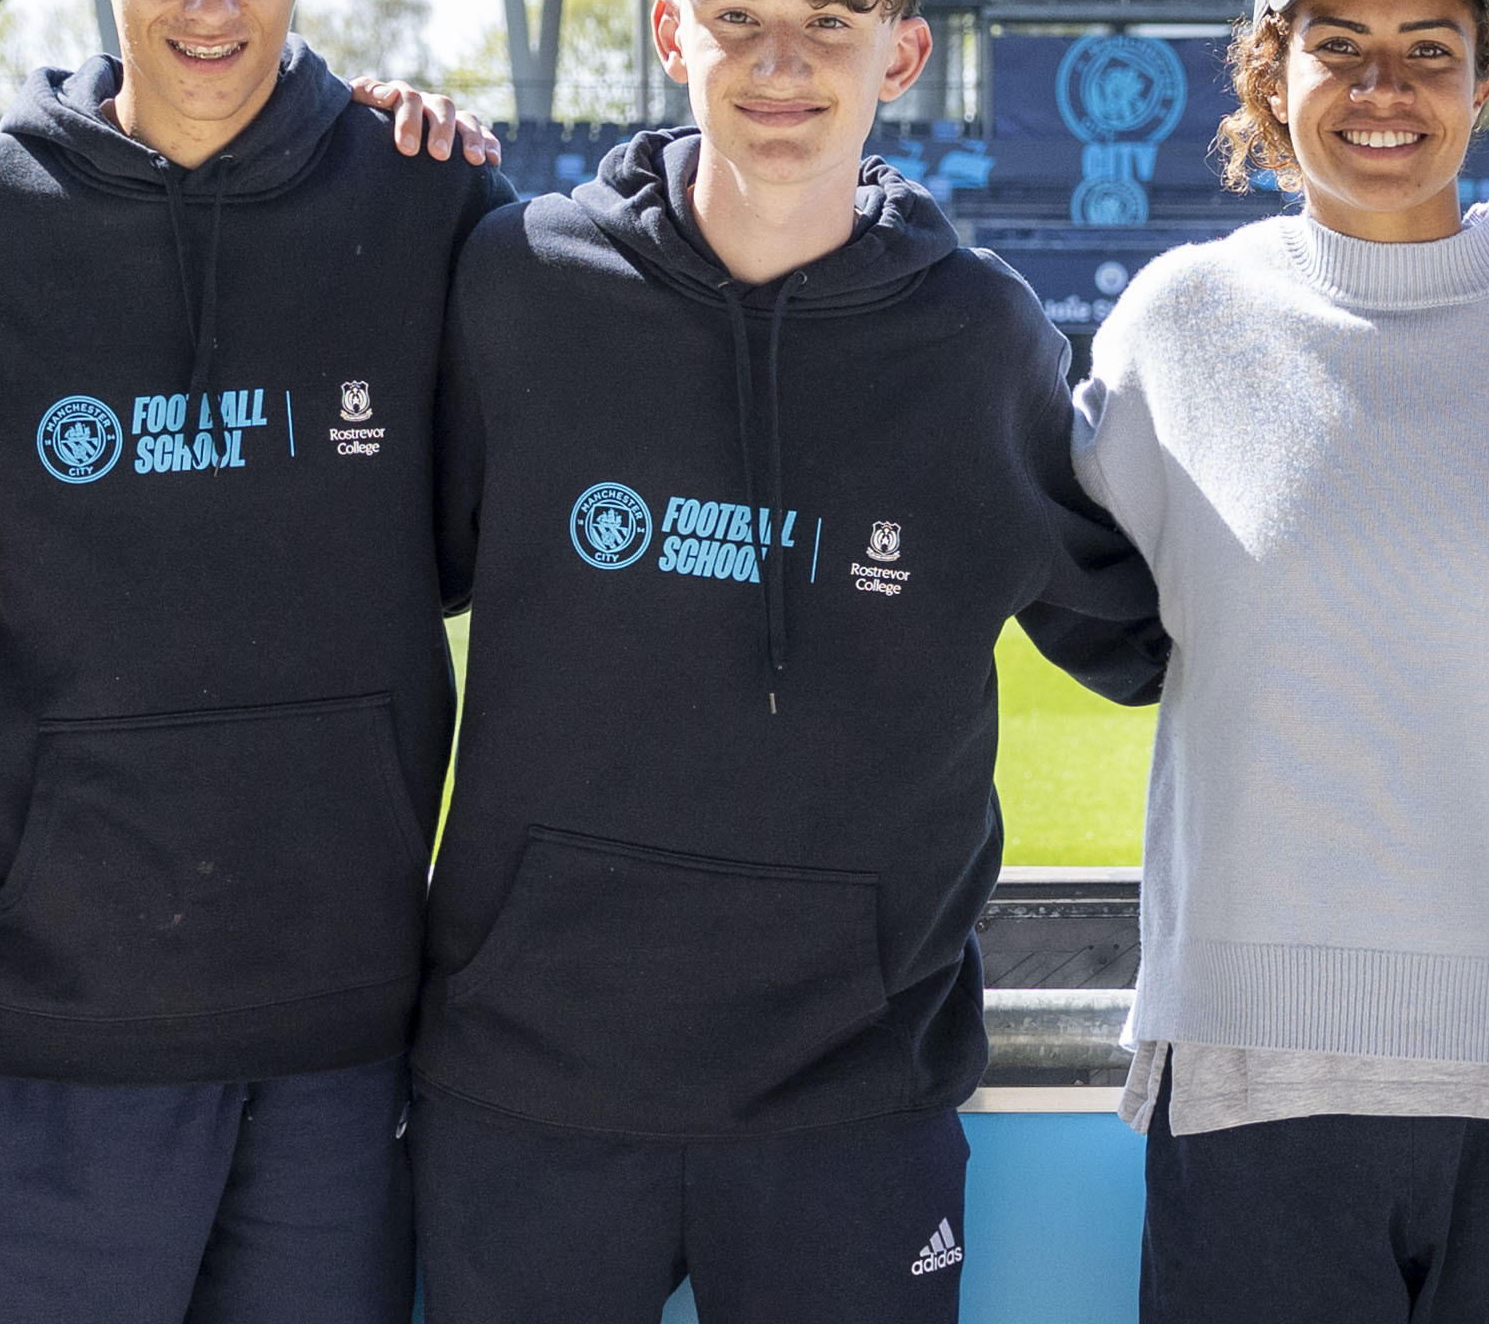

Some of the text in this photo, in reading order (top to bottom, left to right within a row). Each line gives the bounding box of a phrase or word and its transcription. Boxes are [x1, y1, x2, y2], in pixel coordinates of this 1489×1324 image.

[46, 403, 112, 432] MANCHESTER
[132, 388, 267, 435] FOOBALL
[329, 428, 385, 442] Rostrevor
[337, 441, 380, 456] College
[69, 465, 94, 477] CITY
[581, 490, 643, 521] MANCHESTER
[594, 552, 619, 563] CITY
[851, 562, 911, 582] Rostrevor
[856, 578, 902, 596] College
[911, 1246, 963, 1275] adidas
